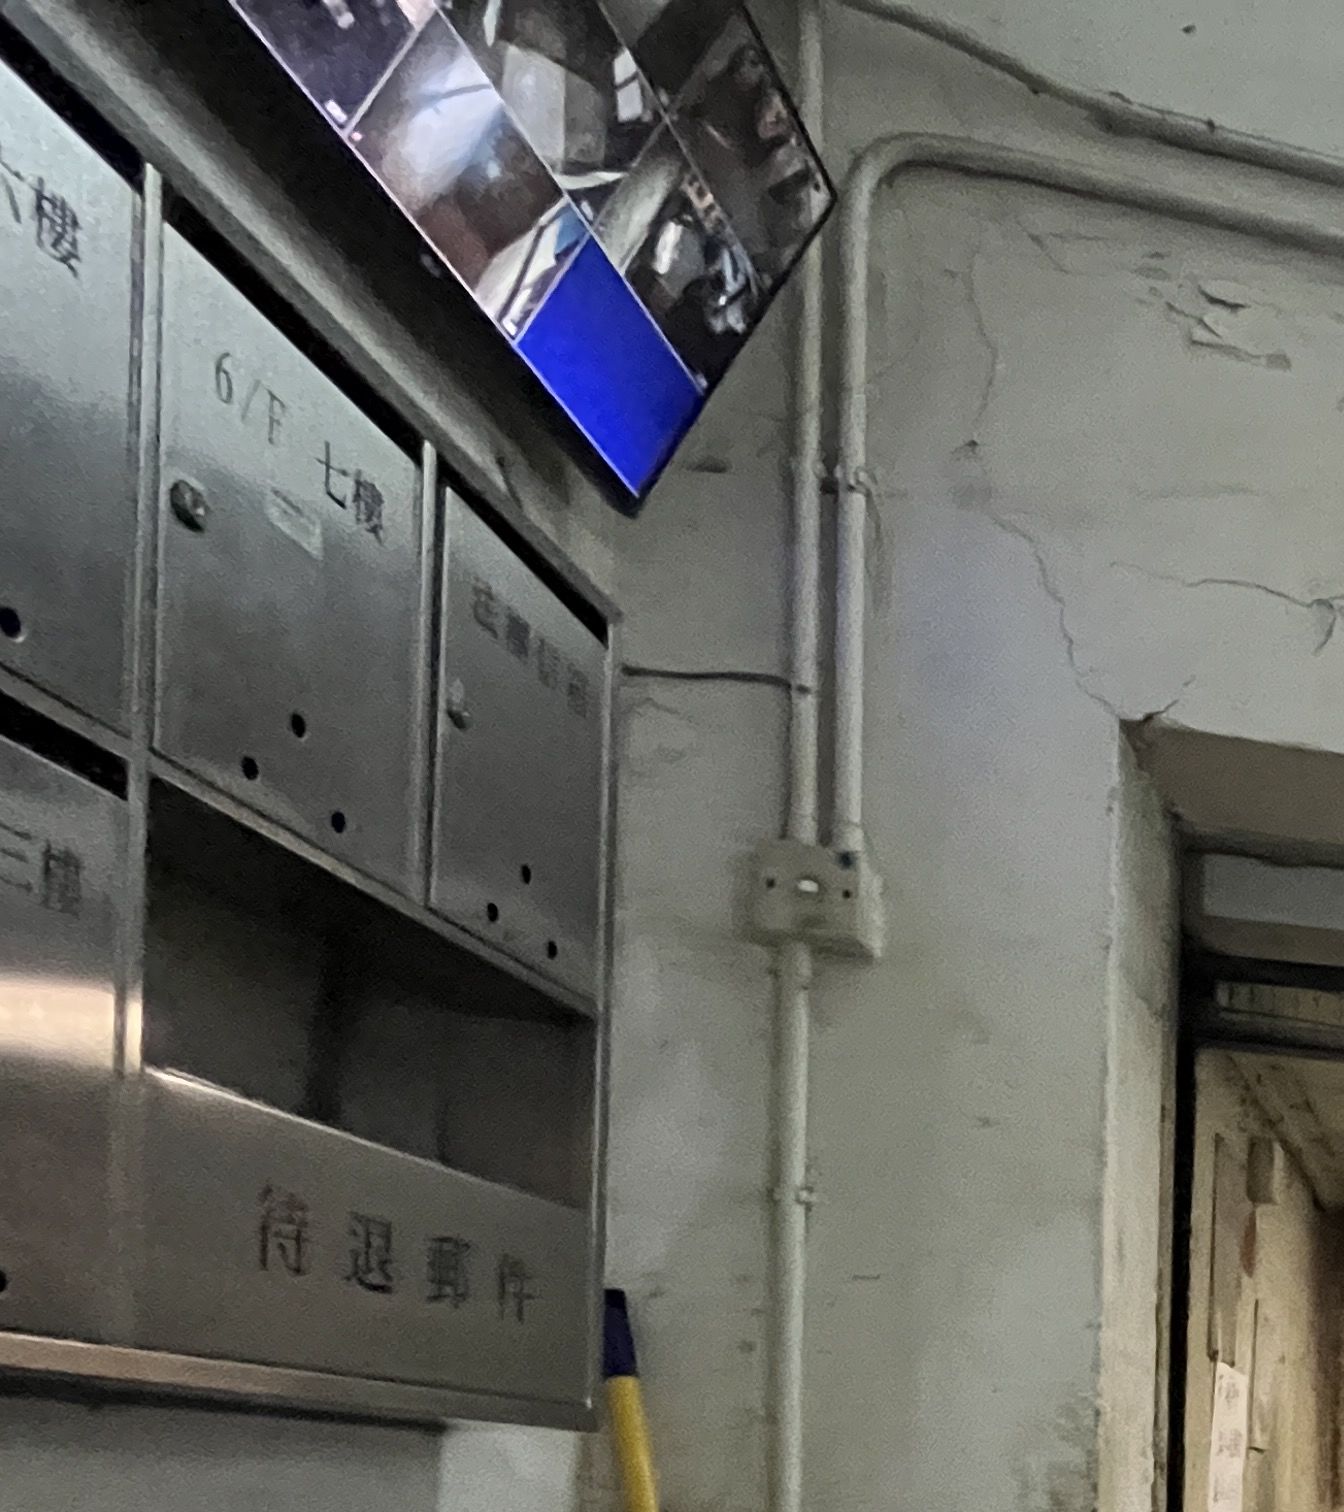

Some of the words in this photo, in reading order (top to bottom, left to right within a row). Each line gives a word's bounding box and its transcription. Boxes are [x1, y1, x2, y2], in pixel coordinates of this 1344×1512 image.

[214, 352, 287, 445] 6/F
[314, 440, 386, 546] 七樓
[257, 1183, 543, 1325] 待退郵件
